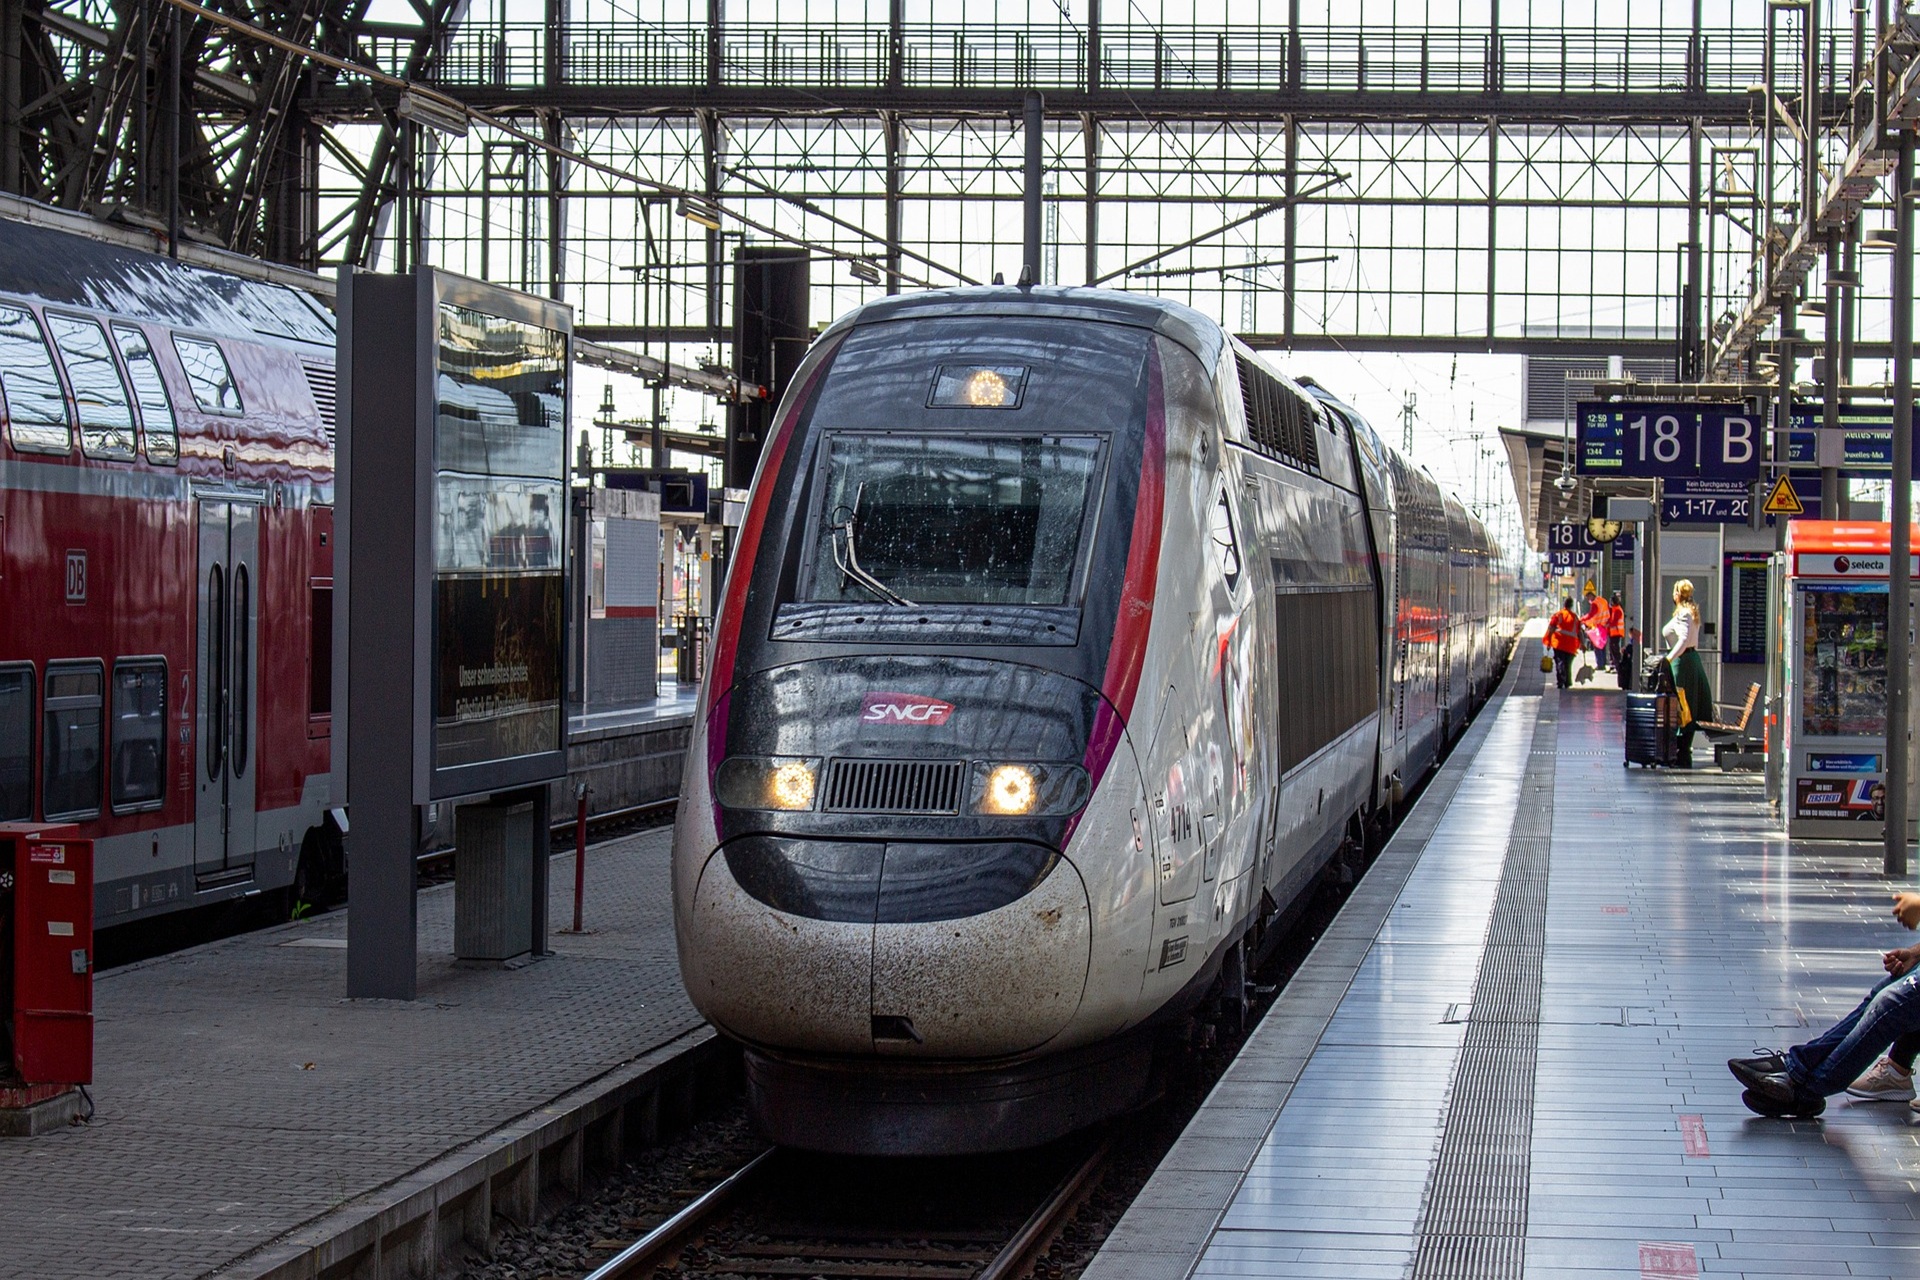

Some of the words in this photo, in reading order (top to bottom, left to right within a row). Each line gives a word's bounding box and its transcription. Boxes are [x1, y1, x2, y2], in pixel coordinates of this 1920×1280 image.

[1630, 415, 1680, 462] 18
[1722, 417, 1752, 463] B
[1700, 481, 1730, 489] Durchgang
[1685, 500, 1716, 515] 1-17
[1552, 525, 1573, 544] 18
[1555, 552, 1569, 564] 18
[1576, 551, 1585, 564] D
[1851, 559, 1884, 569] selecta
[69, 559, 84, 595] DB
[459, 665, 477, 687] Unser
[182, 674, 189, 719] 2
[863, 704, 948, 721] SNCF
[1808, 795, 1840, 803] ZERSTREUT
[1171, 802, 1191, 843] 4714
